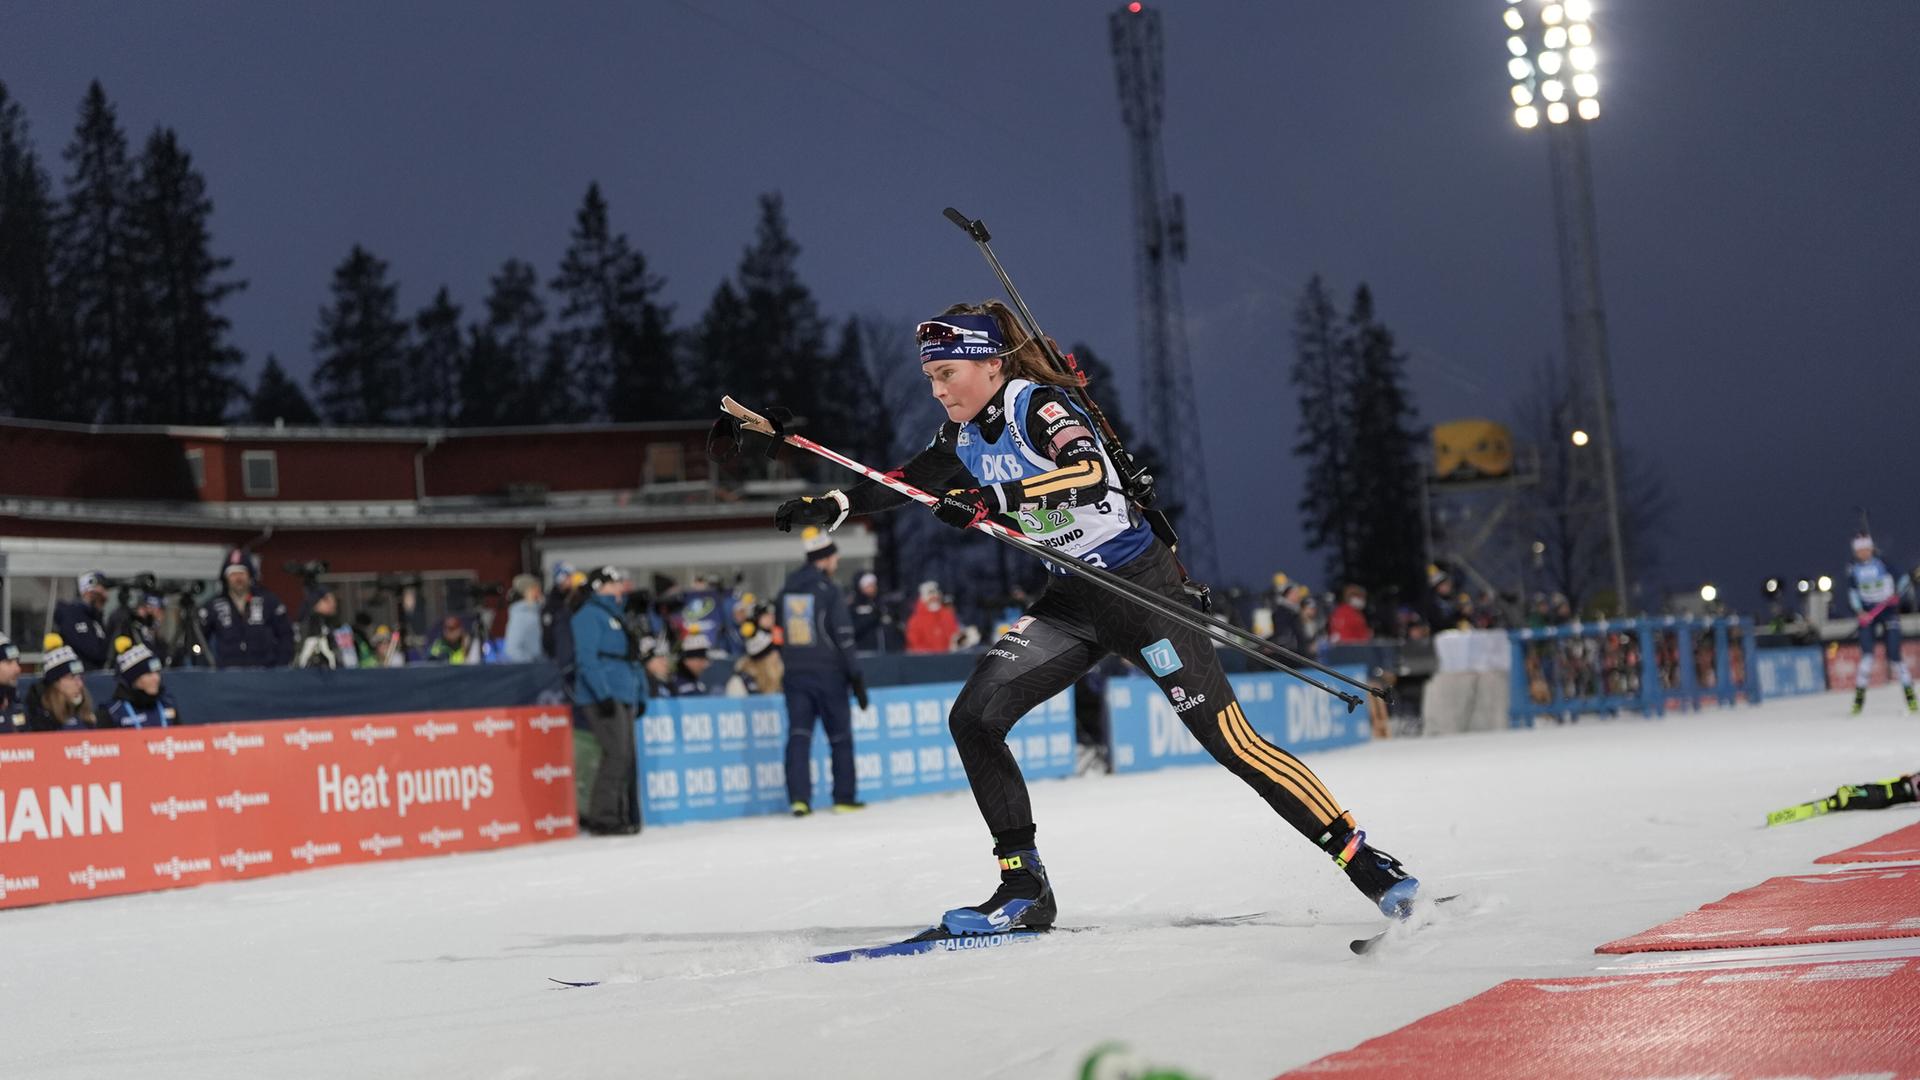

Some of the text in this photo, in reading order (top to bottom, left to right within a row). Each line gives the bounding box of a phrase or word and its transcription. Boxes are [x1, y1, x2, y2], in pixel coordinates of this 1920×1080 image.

[1046, 419, 1080, 436] Kaufland
[980, 454, 1024, 481] DKB
[1047, 510, 1069, 527] 2
[1147, 691, 1202, 758] DK
[0, 748, 35, 763] MANN
[317, 763, 494, 817] Heat pumps
[935, 934, 1014, 951] SALOMON
